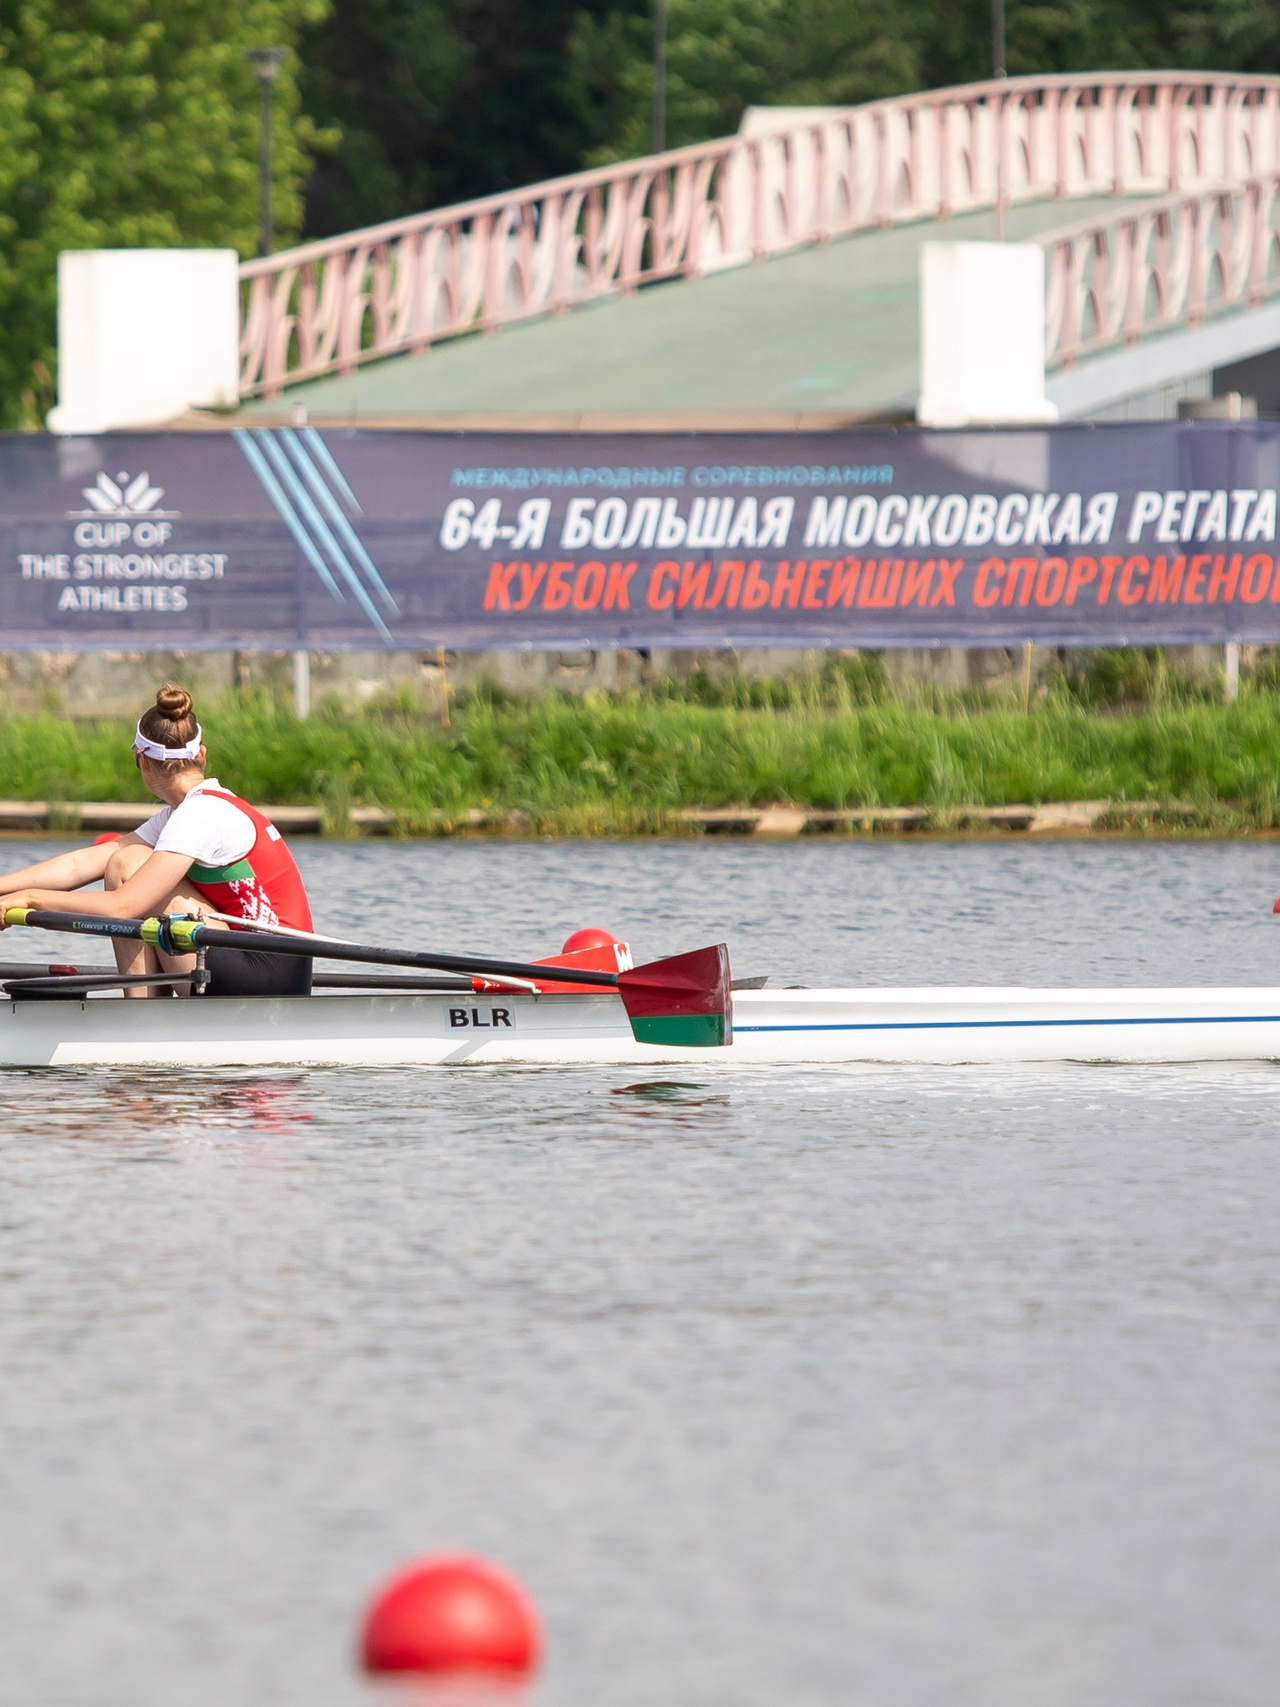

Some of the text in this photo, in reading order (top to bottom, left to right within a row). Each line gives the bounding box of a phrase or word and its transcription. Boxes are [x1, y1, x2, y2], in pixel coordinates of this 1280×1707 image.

[451, 464, 895, 489] МЕЖДУНАРОДНЫЕ СОРЕВНОВАНИЯ
[440, 489, 1277, 551] 64-Я БОЛЬШАЯ МОСКОВСКАЯ РЕГАТА
[74, 522, 173, 549] CUP OF
[19, 554, 228, 580] THE STRONGEST
[482, 560, 639, 612] КУБОК
[646, 555, 964, 610] СИЛЬНЕЙШИХ
[57, 586, 189, 612] ATHLETES
[449, 1008, 512, 1027] BLR
